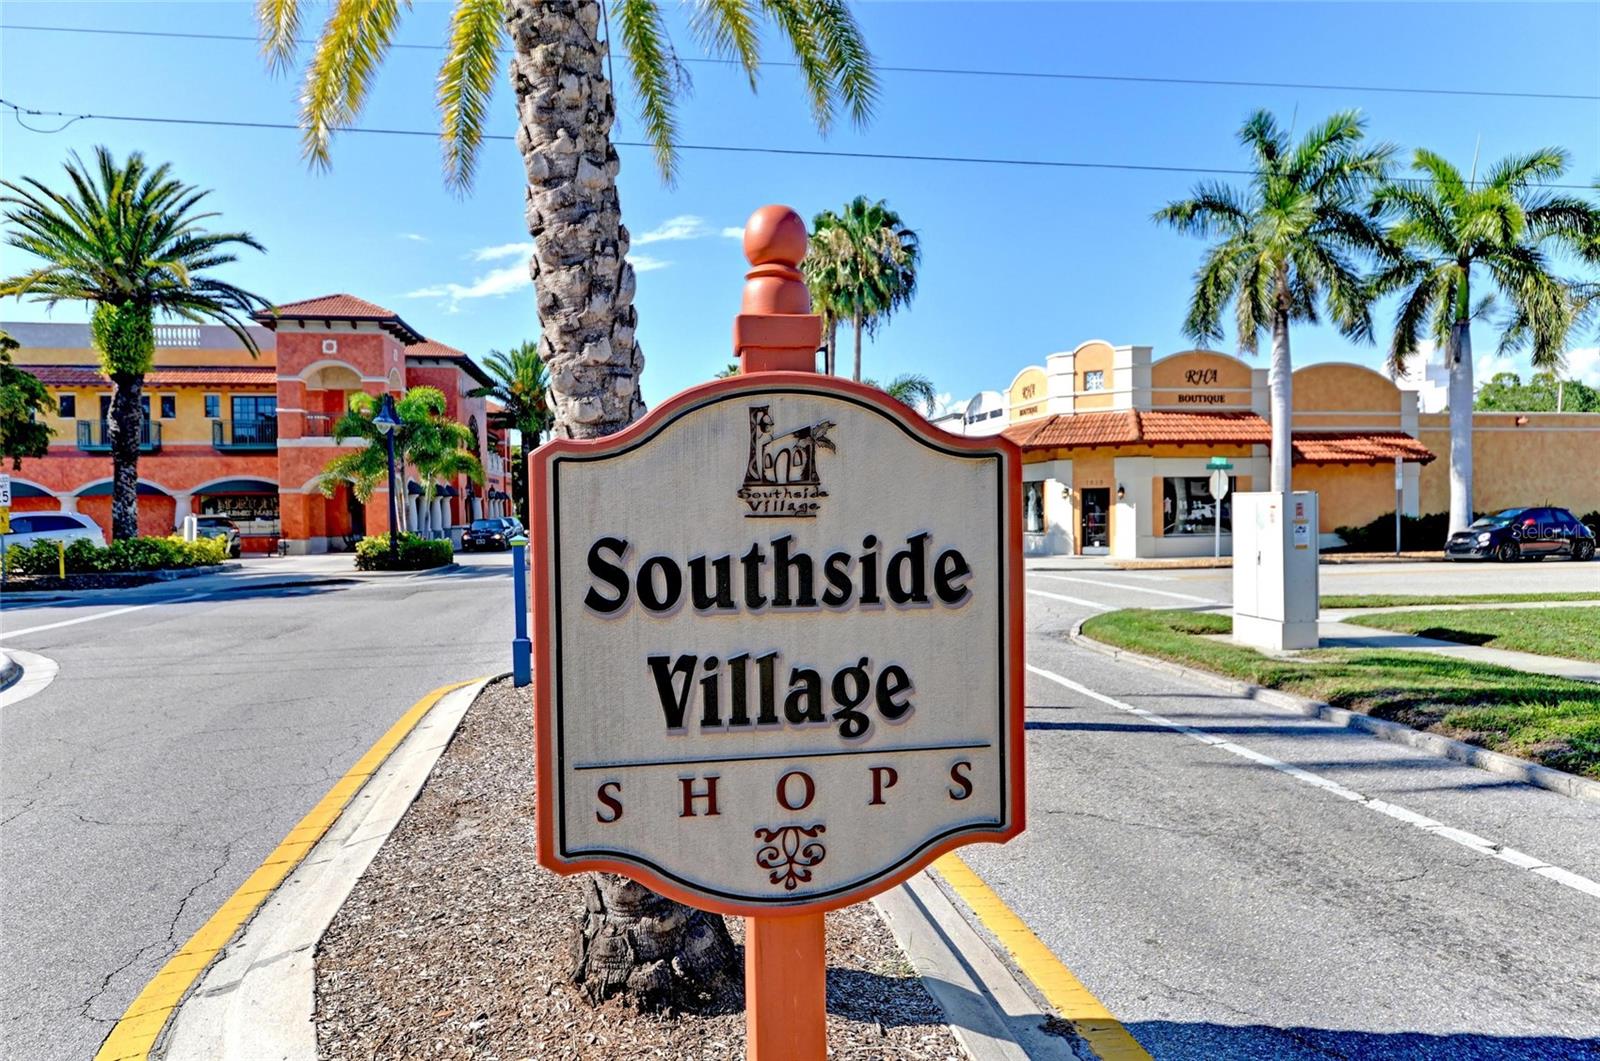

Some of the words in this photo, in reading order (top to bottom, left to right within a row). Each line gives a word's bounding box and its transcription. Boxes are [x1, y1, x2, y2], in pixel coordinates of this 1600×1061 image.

[1185, 368, 1218, 385] RHA
[1178, 394, 1226, 405] BOUTIQUE
[737, 486, 829, 499] Southside
[746, 500, 821, 517] Village
[584, 532, 972, 613] Southside
[647, 651, 914, 740] Village
[595, 761, 974, 823] SHOPS
